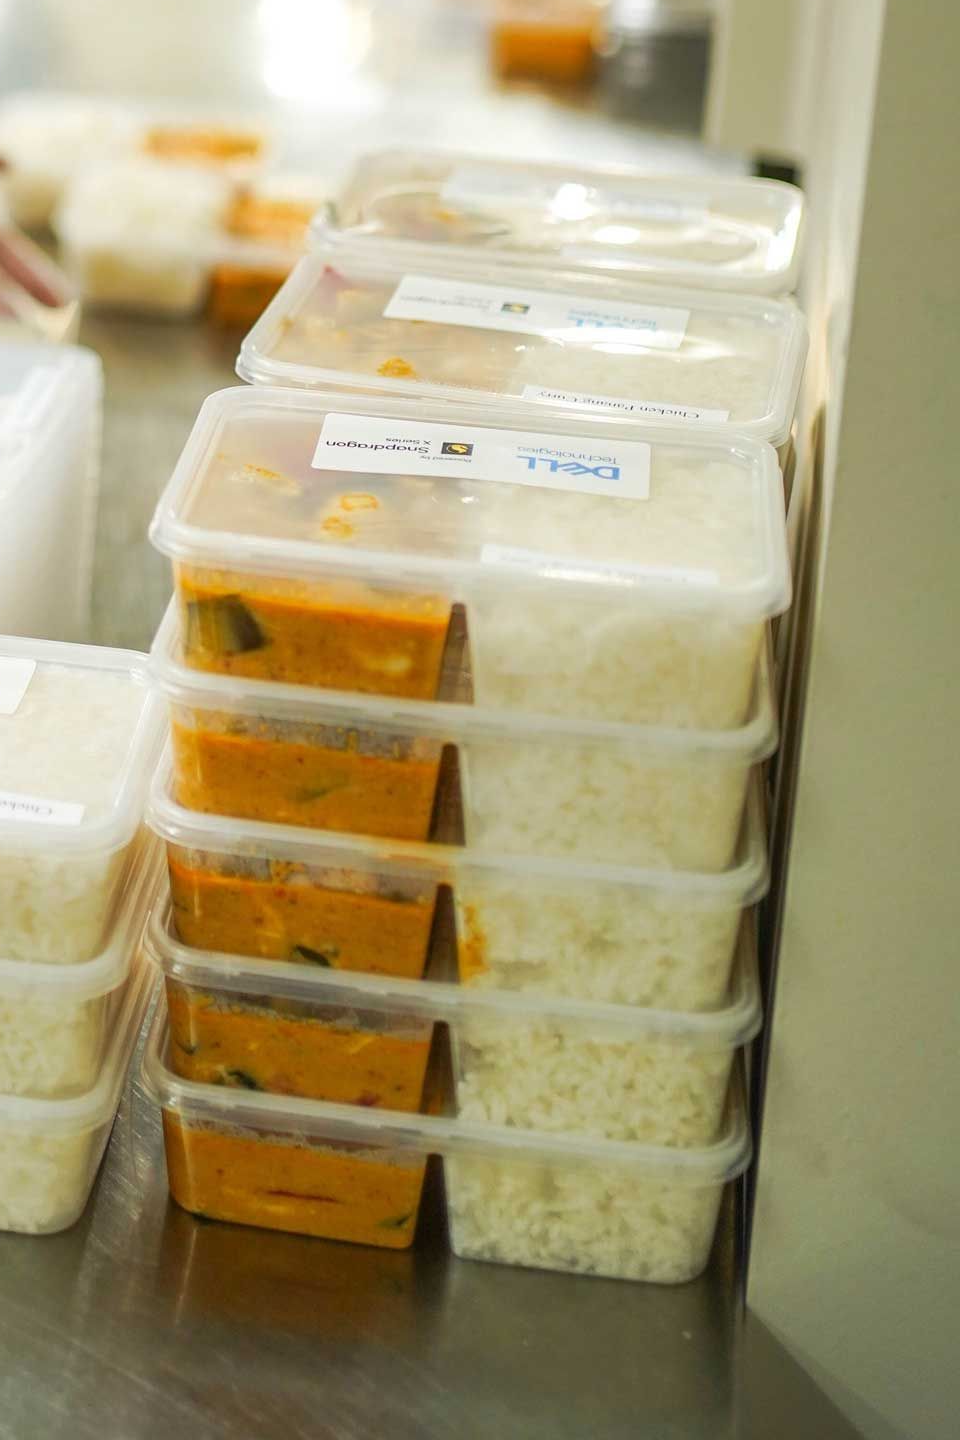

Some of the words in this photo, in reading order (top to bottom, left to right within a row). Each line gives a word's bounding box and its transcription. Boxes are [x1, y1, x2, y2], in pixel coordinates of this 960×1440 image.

[639, 405, 700, 420] Chicken
[325, 440, 429, 453] Snapdragon
[385, 437, 420, 445] Series
[516, 446, 619, 465] Technologies
[516, 456, 620, 481] DELL
